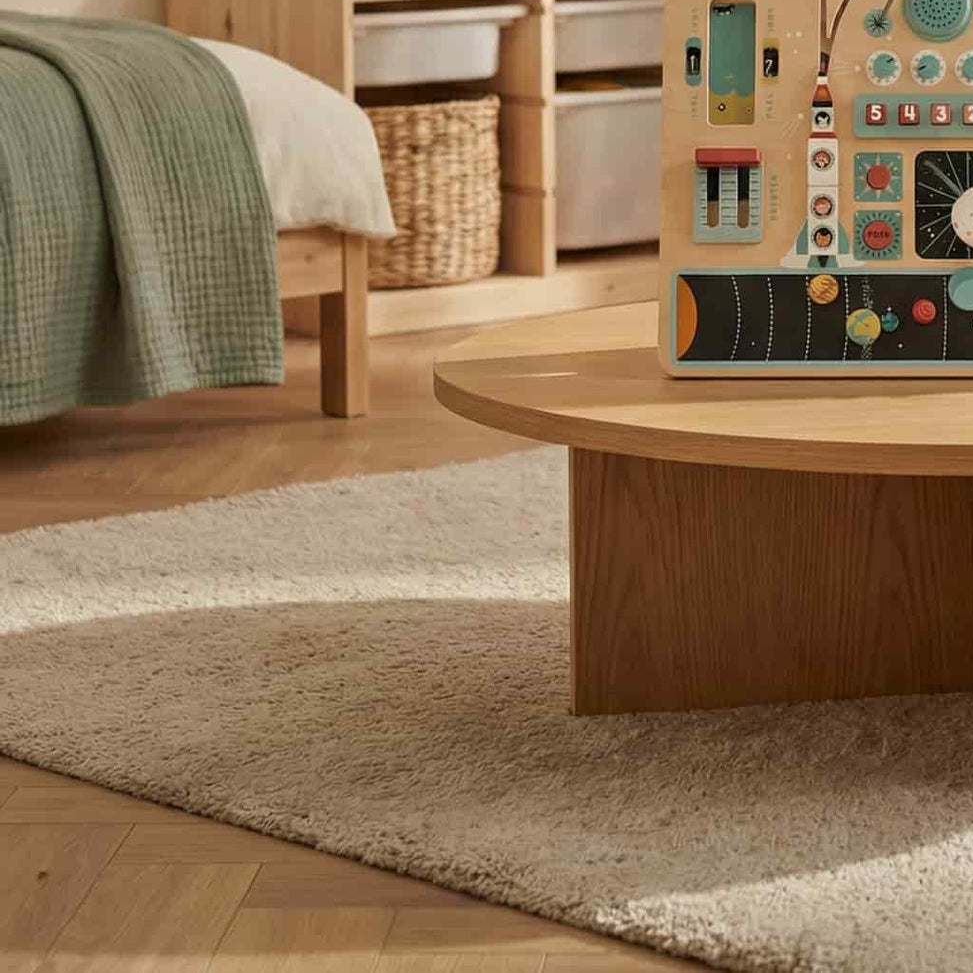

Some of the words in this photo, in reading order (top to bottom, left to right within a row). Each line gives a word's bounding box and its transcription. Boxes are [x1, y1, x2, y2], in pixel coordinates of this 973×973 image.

[870, 104, 882, 121] 5
[904, 104, 916, 121] 4
[936, 105, 948, 122] 3
